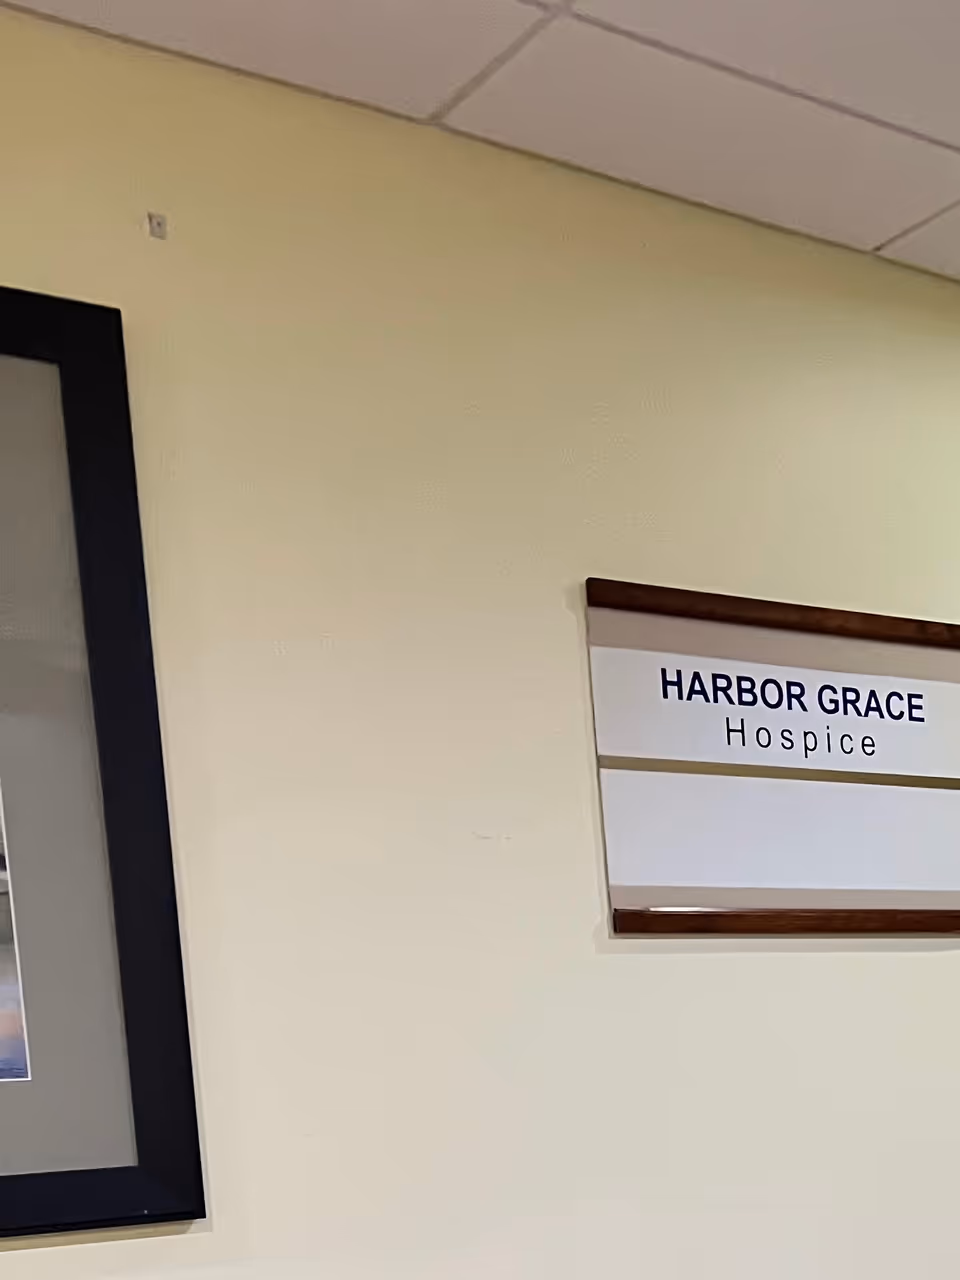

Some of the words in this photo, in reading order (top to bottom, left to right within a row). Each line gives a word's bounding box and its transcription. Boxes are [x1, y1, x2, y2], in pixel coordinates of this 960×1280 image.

[660, 667, 808, 712] HARBOR
[817, 684, 925, 723] GRACE
[725, 716, 876, 758] Hospice
